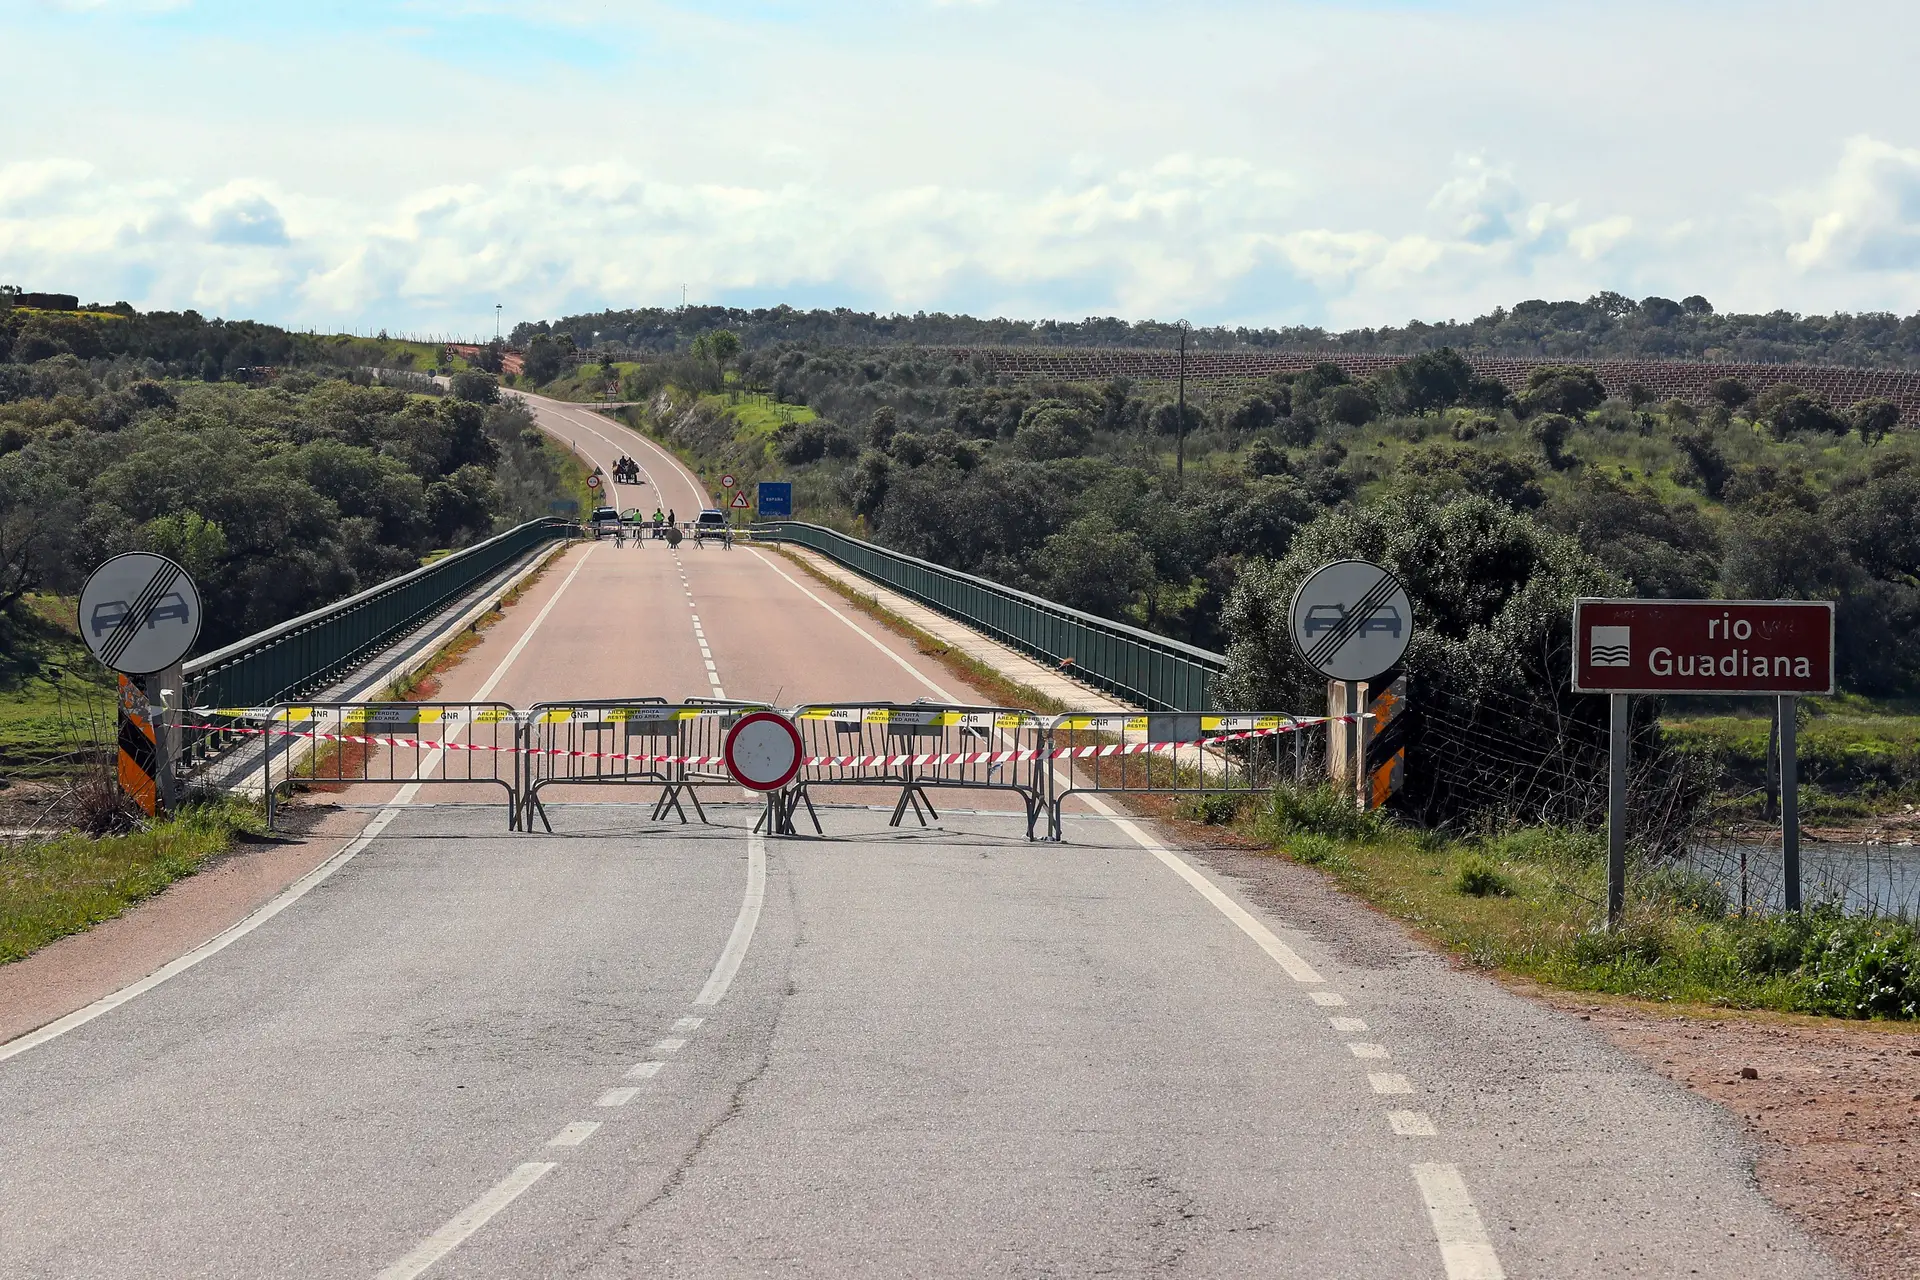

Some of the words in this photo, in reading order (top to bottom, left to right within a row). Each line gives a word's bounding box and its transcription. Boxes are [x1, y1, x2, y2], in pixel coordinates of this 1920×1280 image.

[1709, 612, 1752, 640] rio
[1648, 646, 1811, 678] Guadiana
[1090, 718, 1109, 726] GNR
[1220, 718, 1238, 726] GNR
